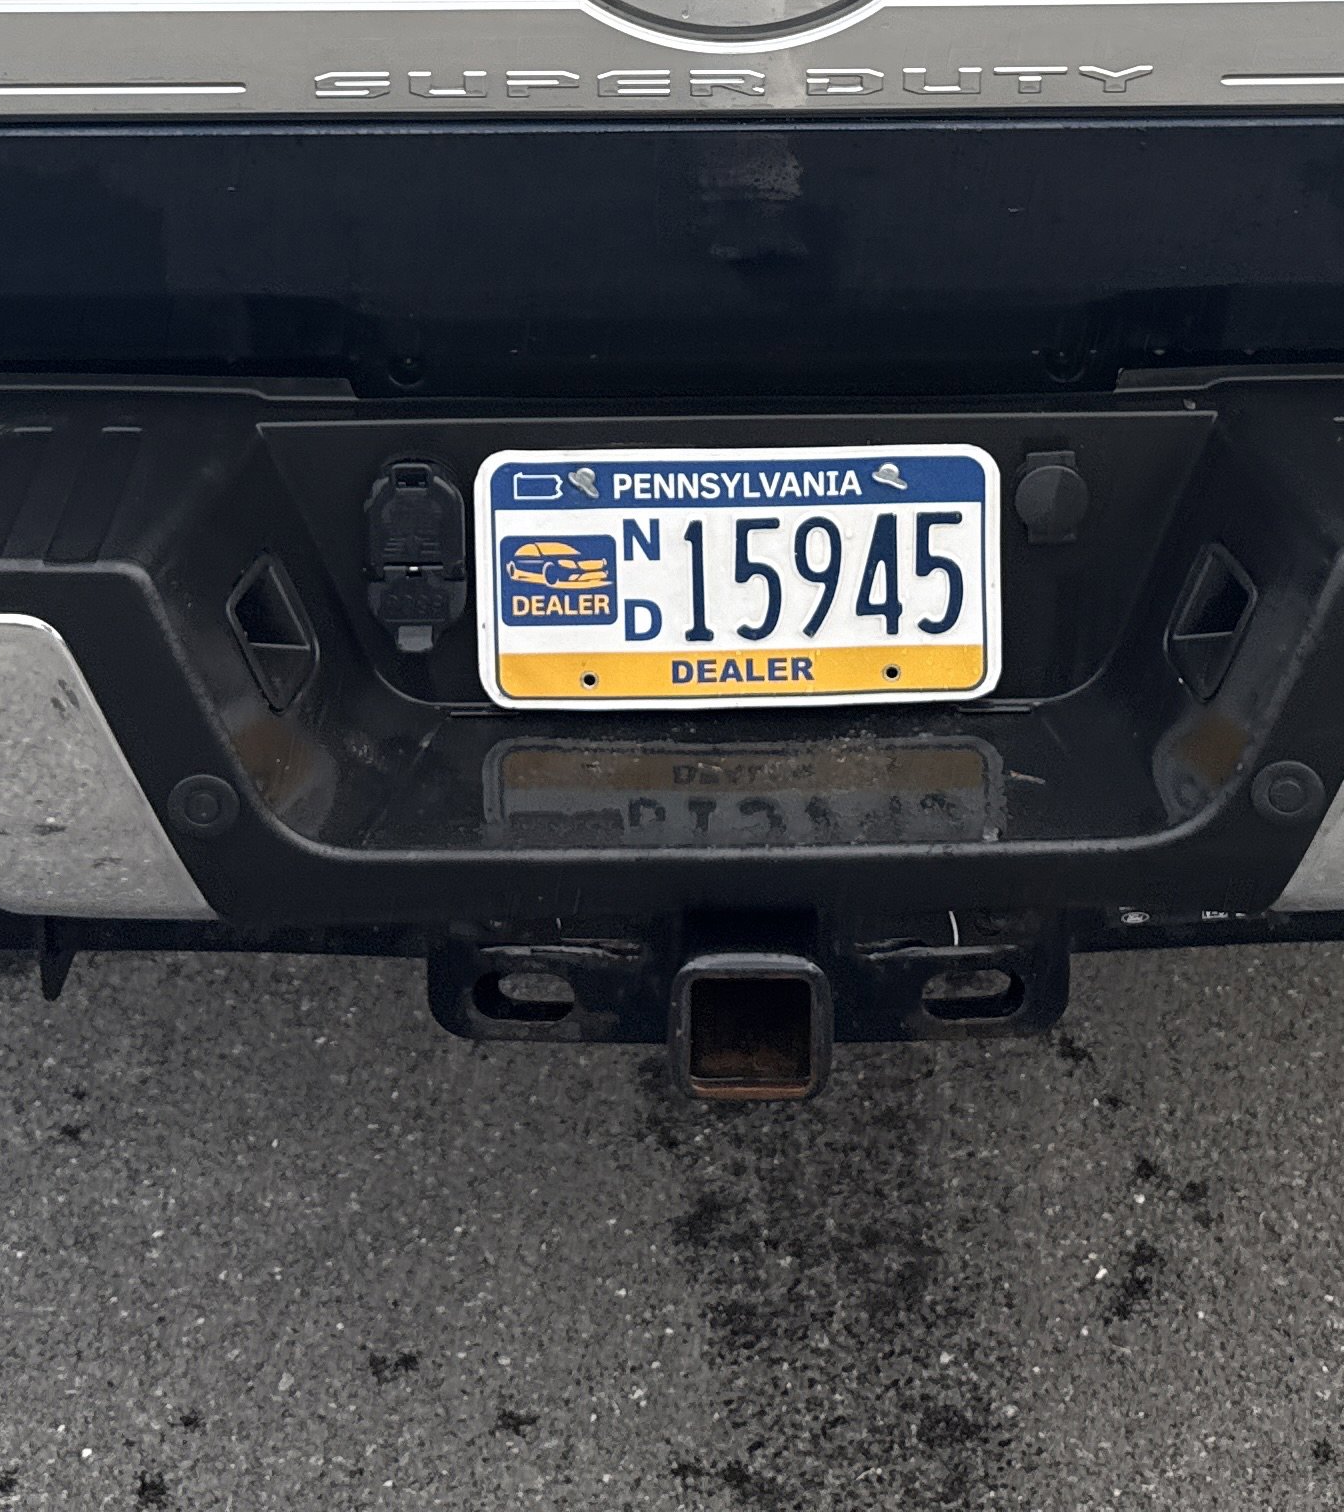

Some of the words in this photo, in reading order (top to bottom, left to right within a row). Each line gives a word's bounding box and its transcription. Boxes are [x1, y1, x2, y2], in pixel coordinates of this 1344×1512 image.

[314, 68, 765, 99] SUPER
[806, 64, 1154, 97] DUTY
[612, 469, 863, 501] PENNSYLVANIA
[683, 510, 965, 643] 15945
[511, 593, 611, 618] DEALER
[670, 656, 815, 685] DEALER
